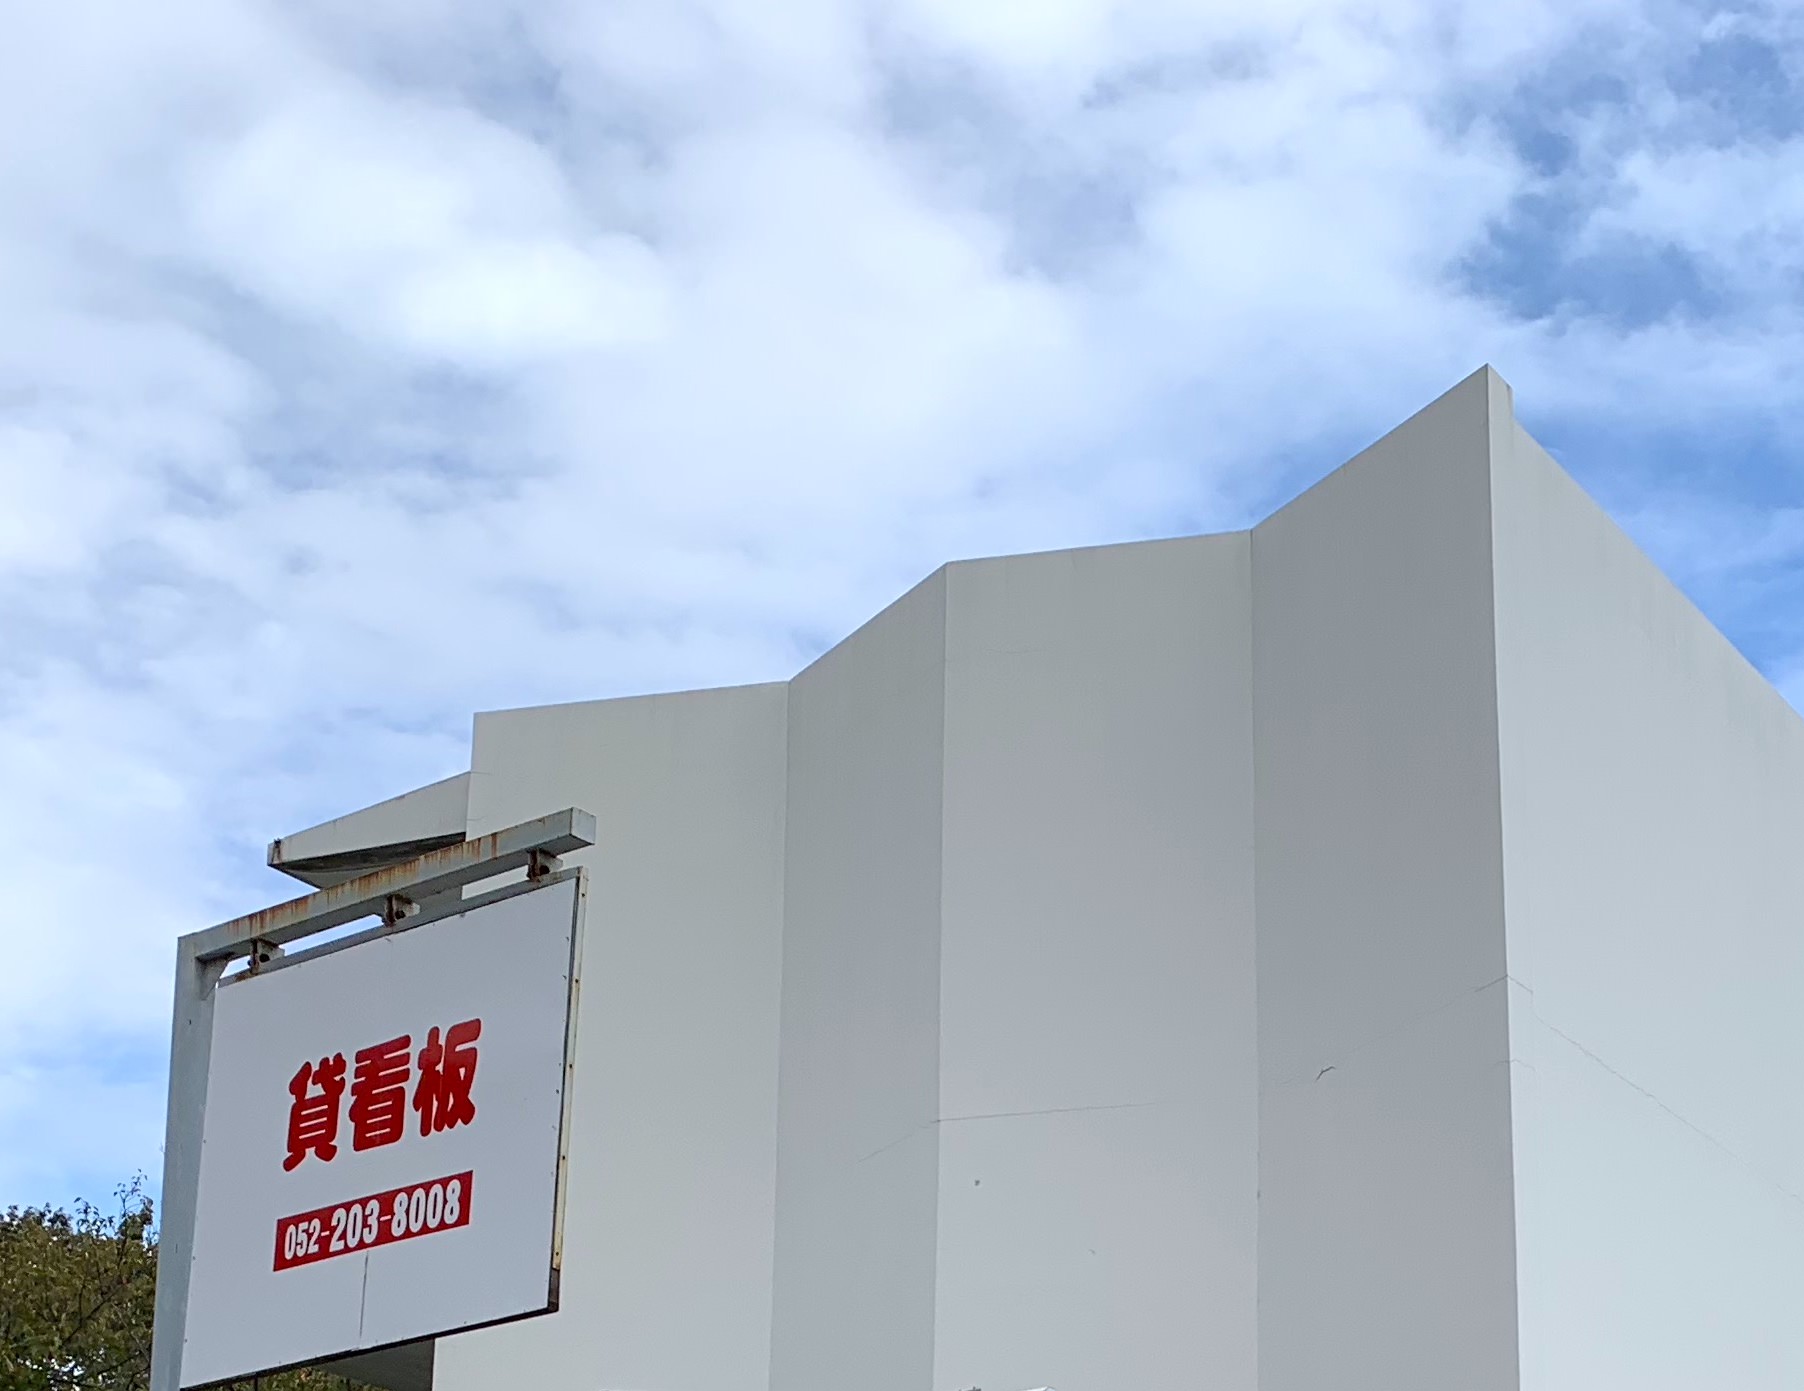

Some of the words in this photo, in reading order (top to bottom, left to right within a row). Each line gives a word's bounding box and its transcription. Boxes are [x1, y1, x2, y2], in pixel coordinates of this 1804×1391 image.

[283, 1018, 482, 1171] 貸看板
[284, 1179, 462, 1260] 052-203-8008
